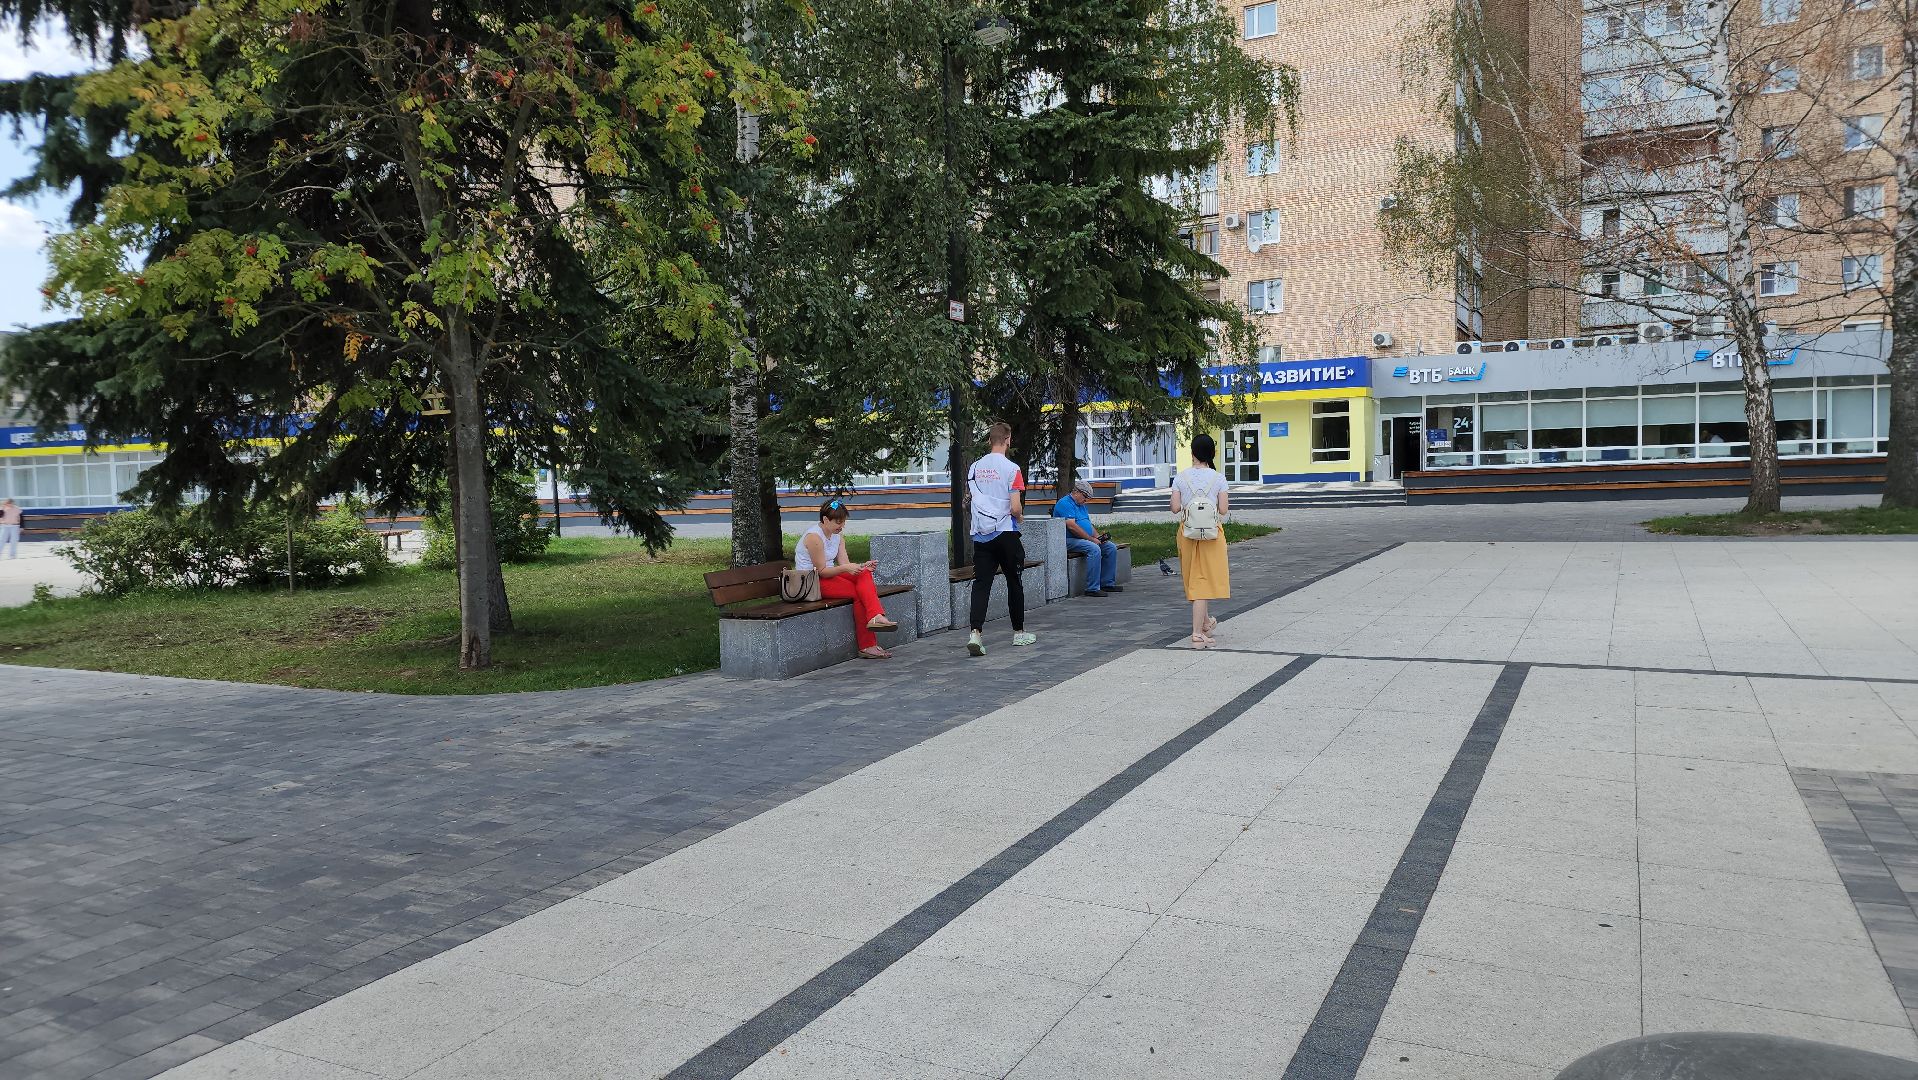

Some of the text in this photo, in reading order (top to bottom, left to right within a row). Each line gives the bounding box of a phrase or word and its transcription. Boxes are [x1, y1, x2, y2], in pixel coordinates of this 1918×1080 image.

[1409, 366, 1476, 385] ВТБ БАНК
[1453, 416, 1469, 429] 24
